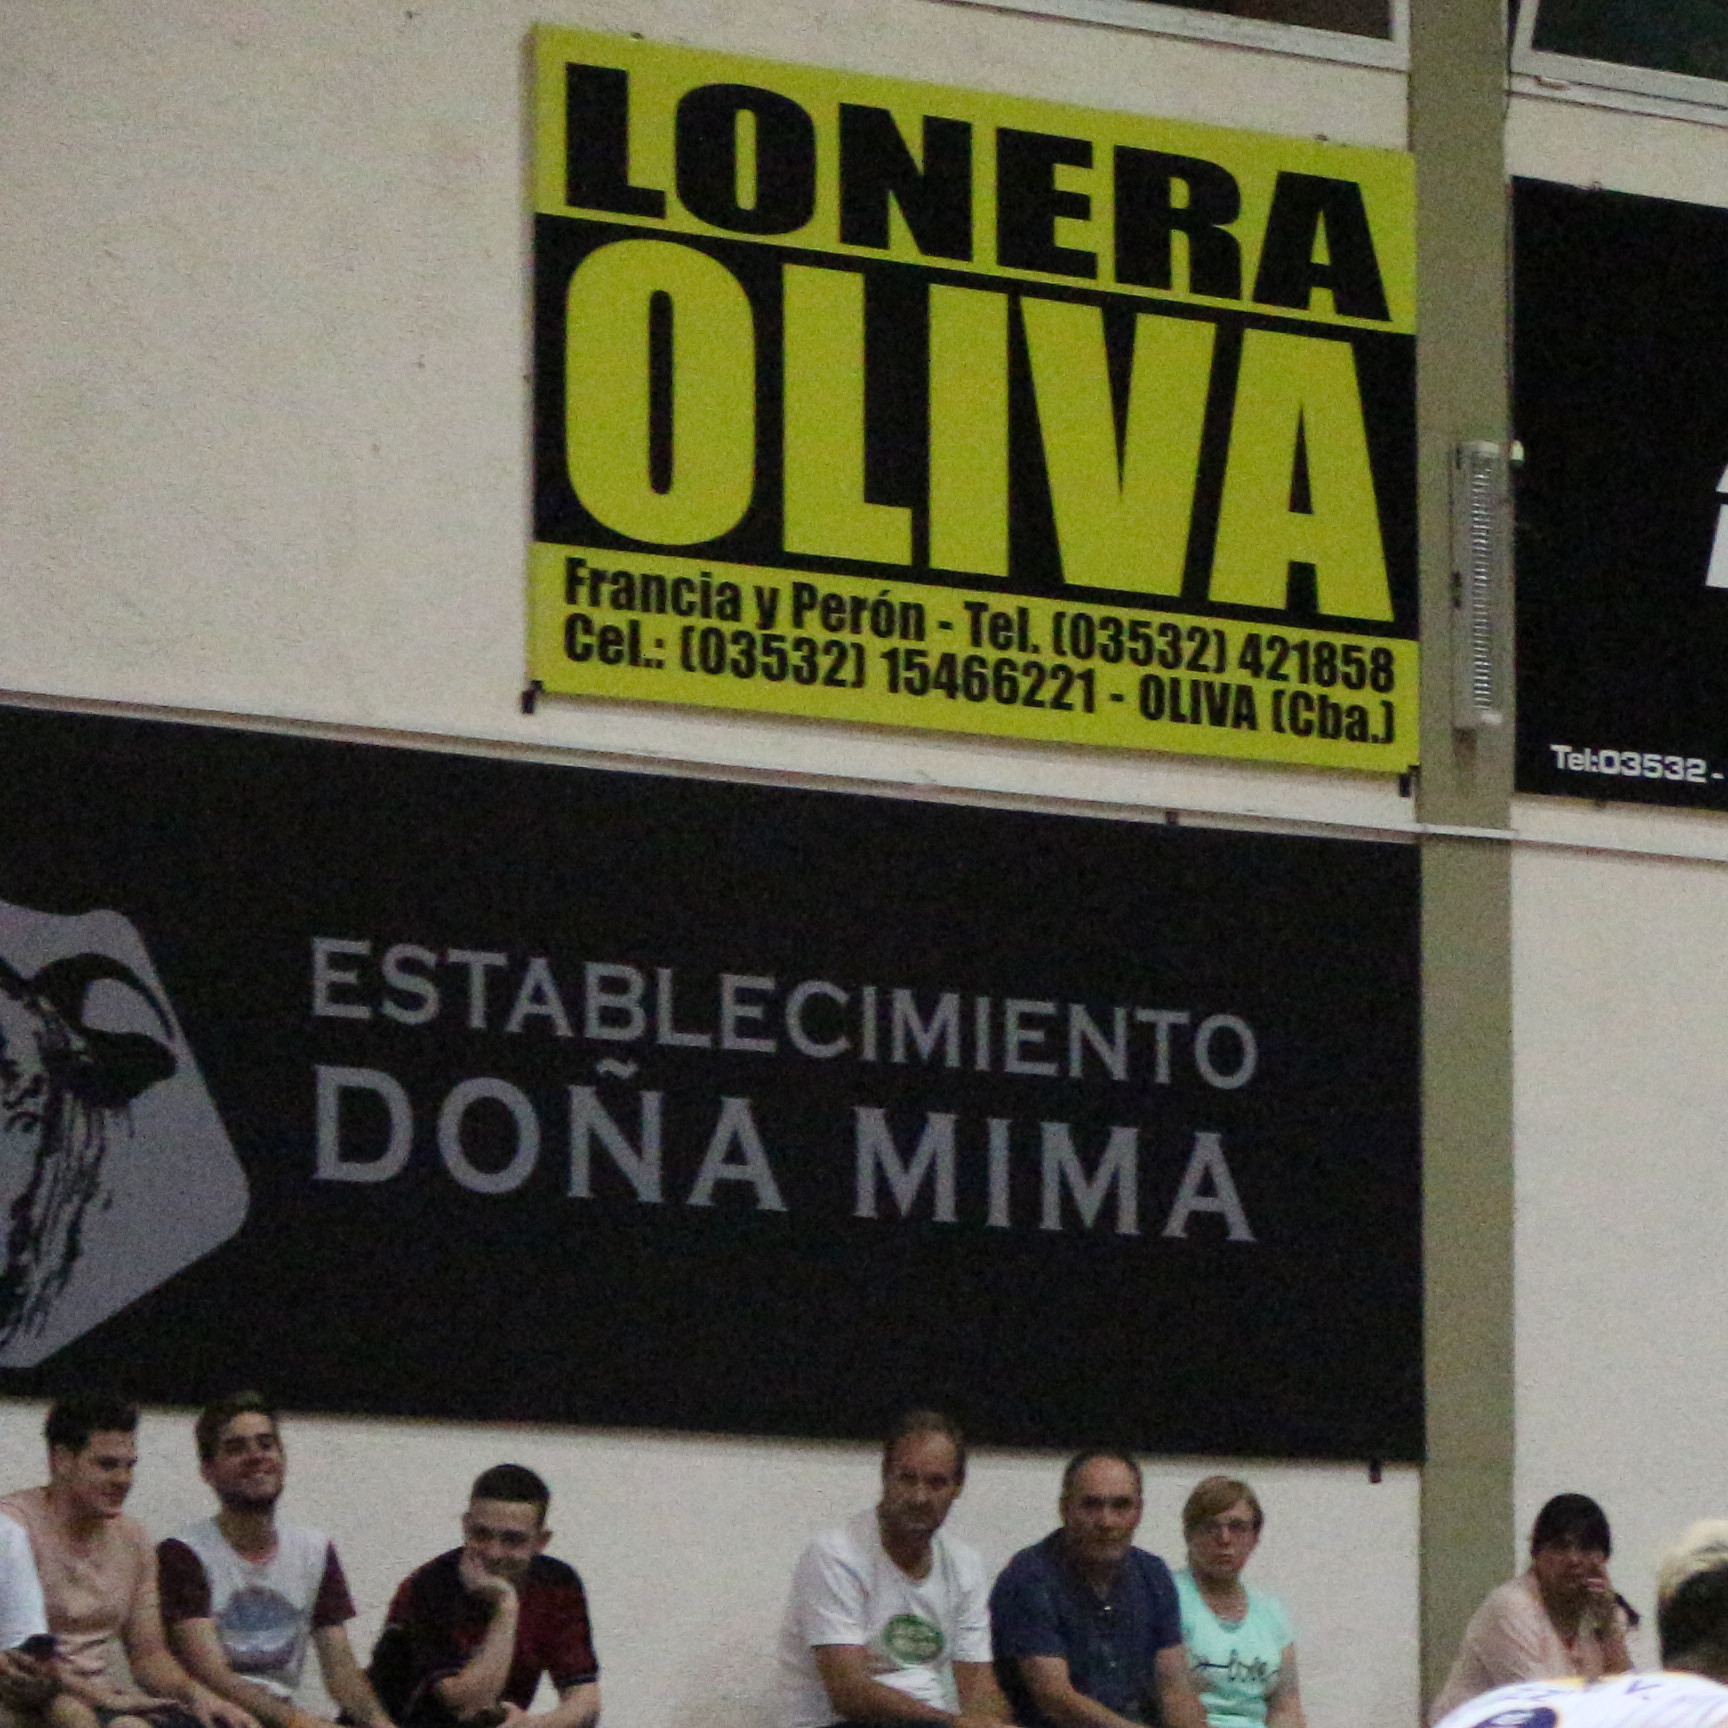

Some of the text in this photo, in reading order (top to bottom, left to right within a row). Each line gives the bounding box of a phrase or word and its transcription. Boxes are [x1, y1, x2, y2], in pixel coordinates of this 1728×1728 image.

[566, 62, 1392, 322] LONERA
[565, 238, 1394, 623] OLIVA
[565, 557, 1393, 694] Francia y Perón Tel. (03532) 421858
[565, 614, 1394, 746] Cel.: (03532) 15466221 OLIVA (Cba.)
[1550, 744, 1706, 784] Tel:03532
[310, 935, 1258, 1090] ESTABLECIMIENTO
[312, 1057, 1258, 1244] DOÑA MIMA
